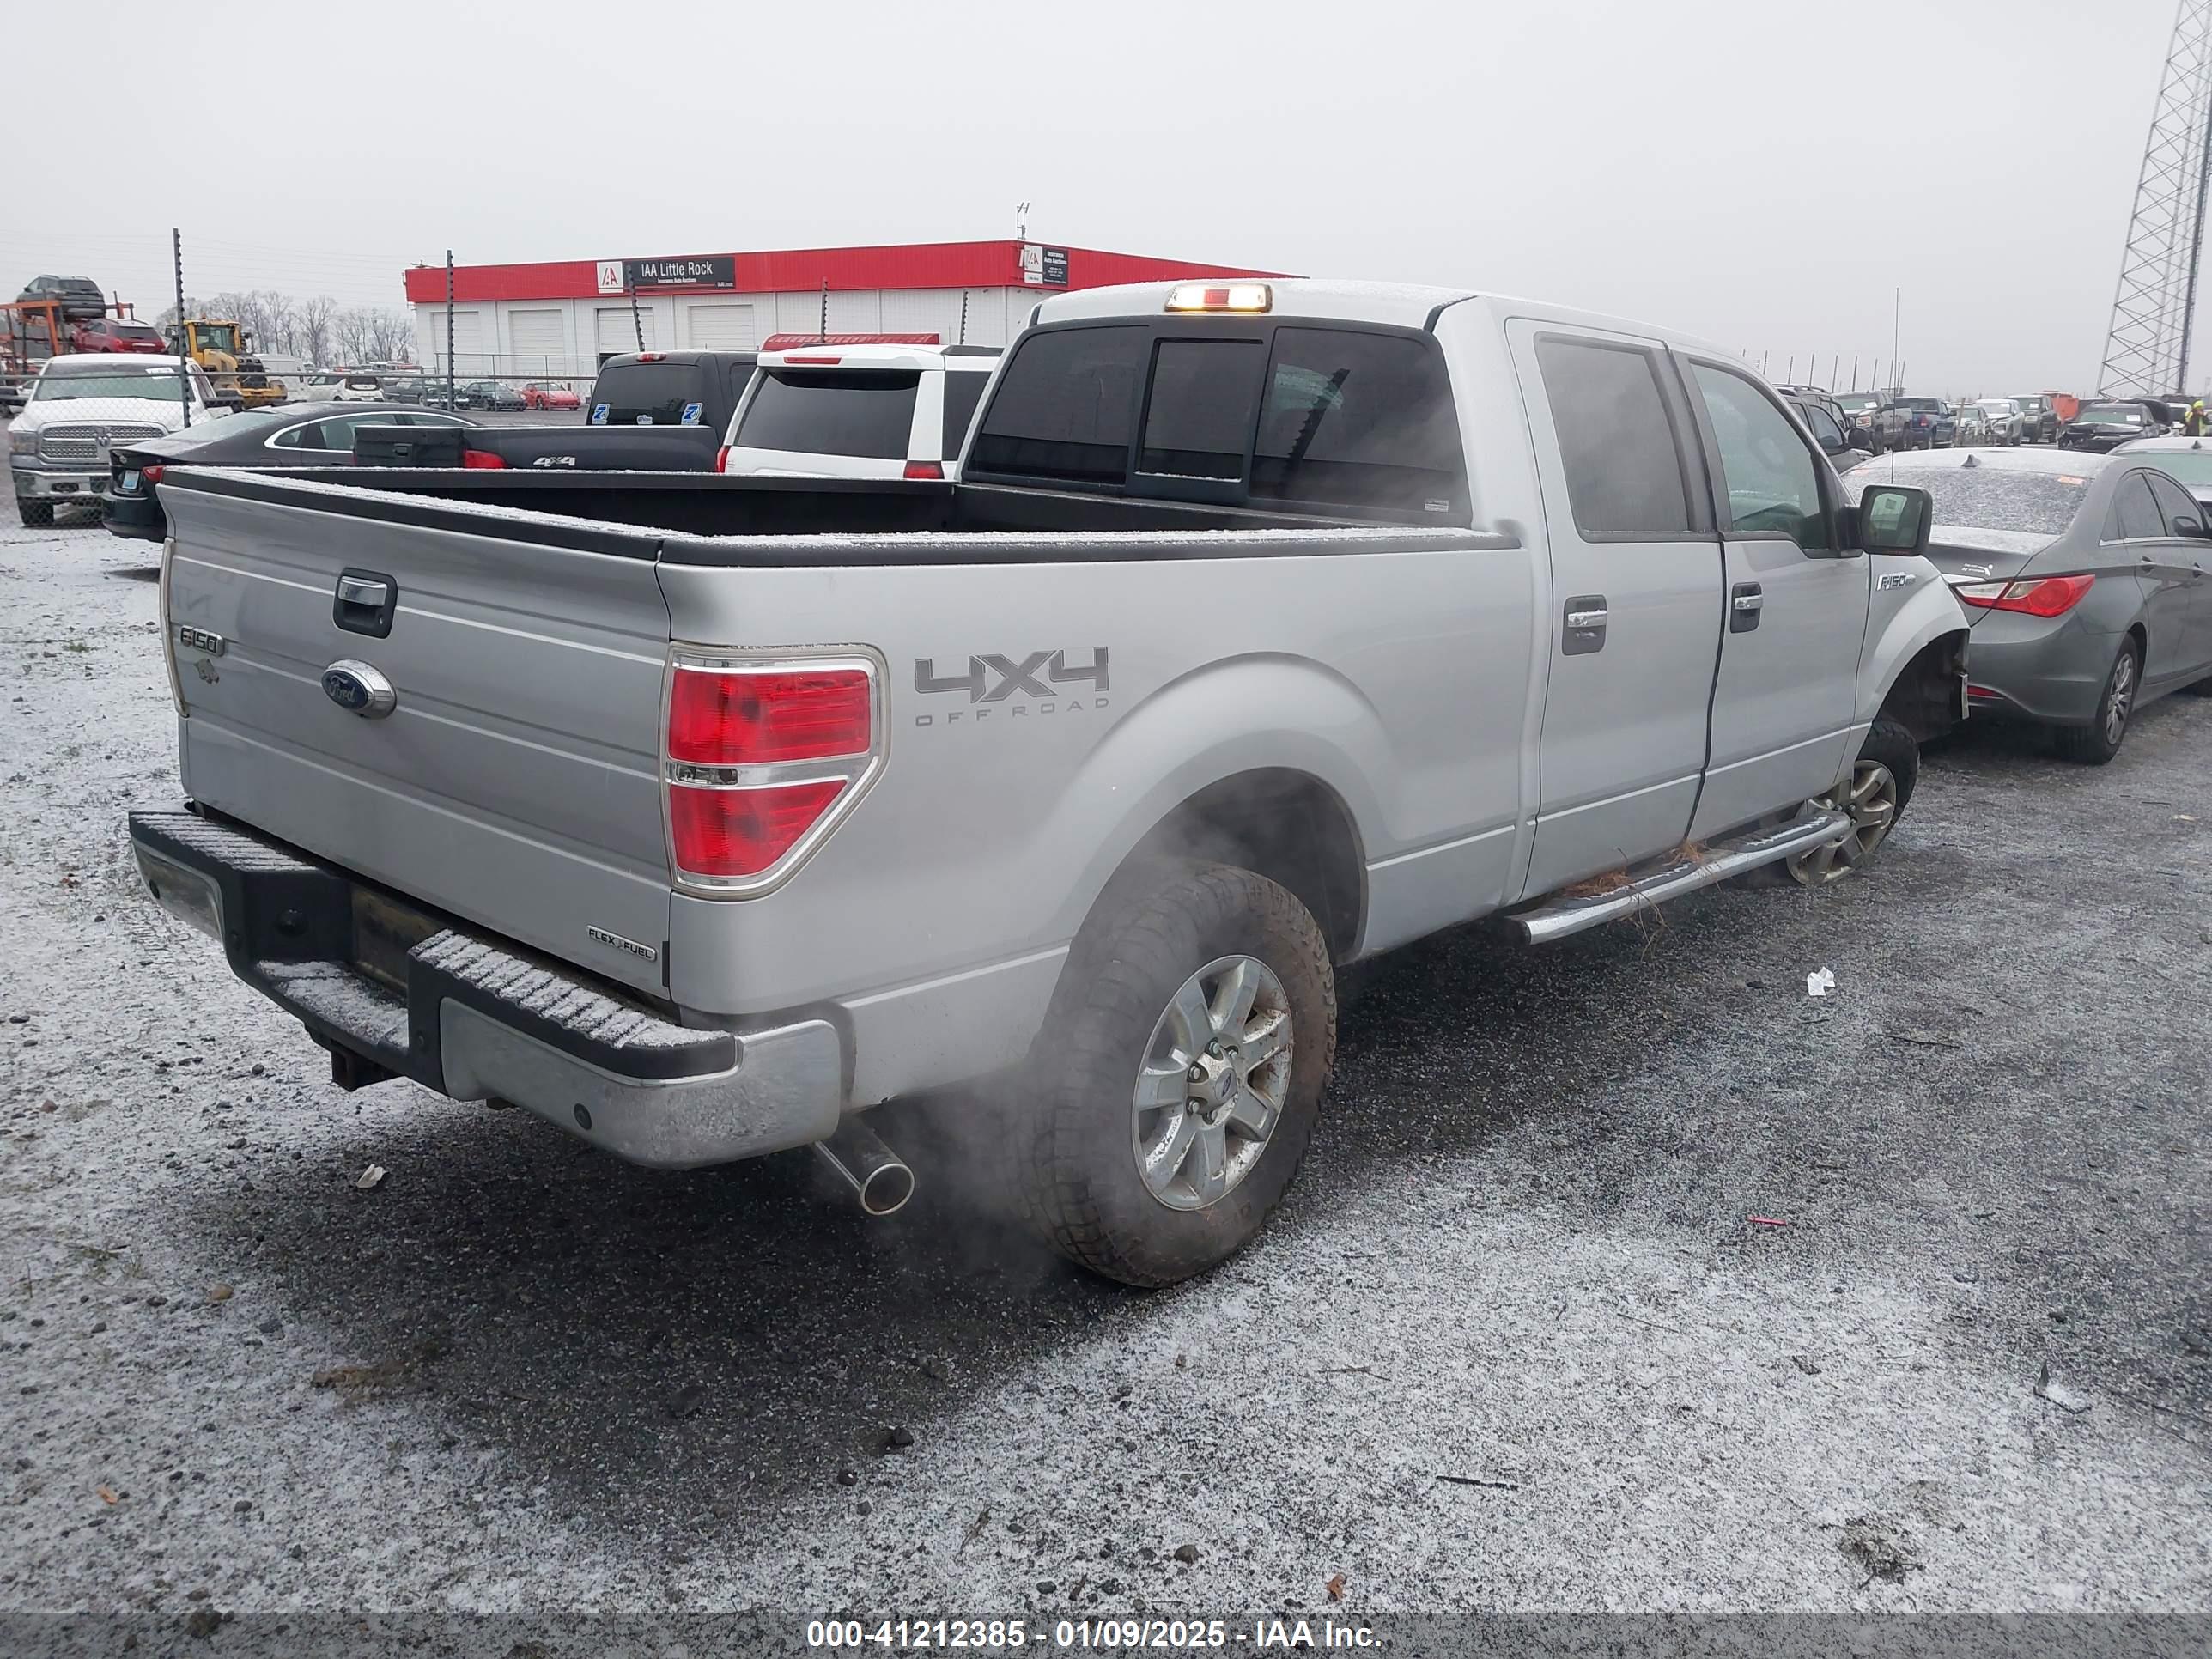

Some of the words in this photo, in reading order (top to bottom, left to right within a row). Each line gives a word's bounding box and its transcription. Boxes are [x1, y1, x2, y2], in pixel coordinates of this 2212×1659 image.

[641, 264, 658, 277] IAA
[660, 262, 685, 276] Little
[688, 261, 713, 276] Rock
[588, 928, 615, 945] FLEX
[623, 941, 653, 959] FUEL
